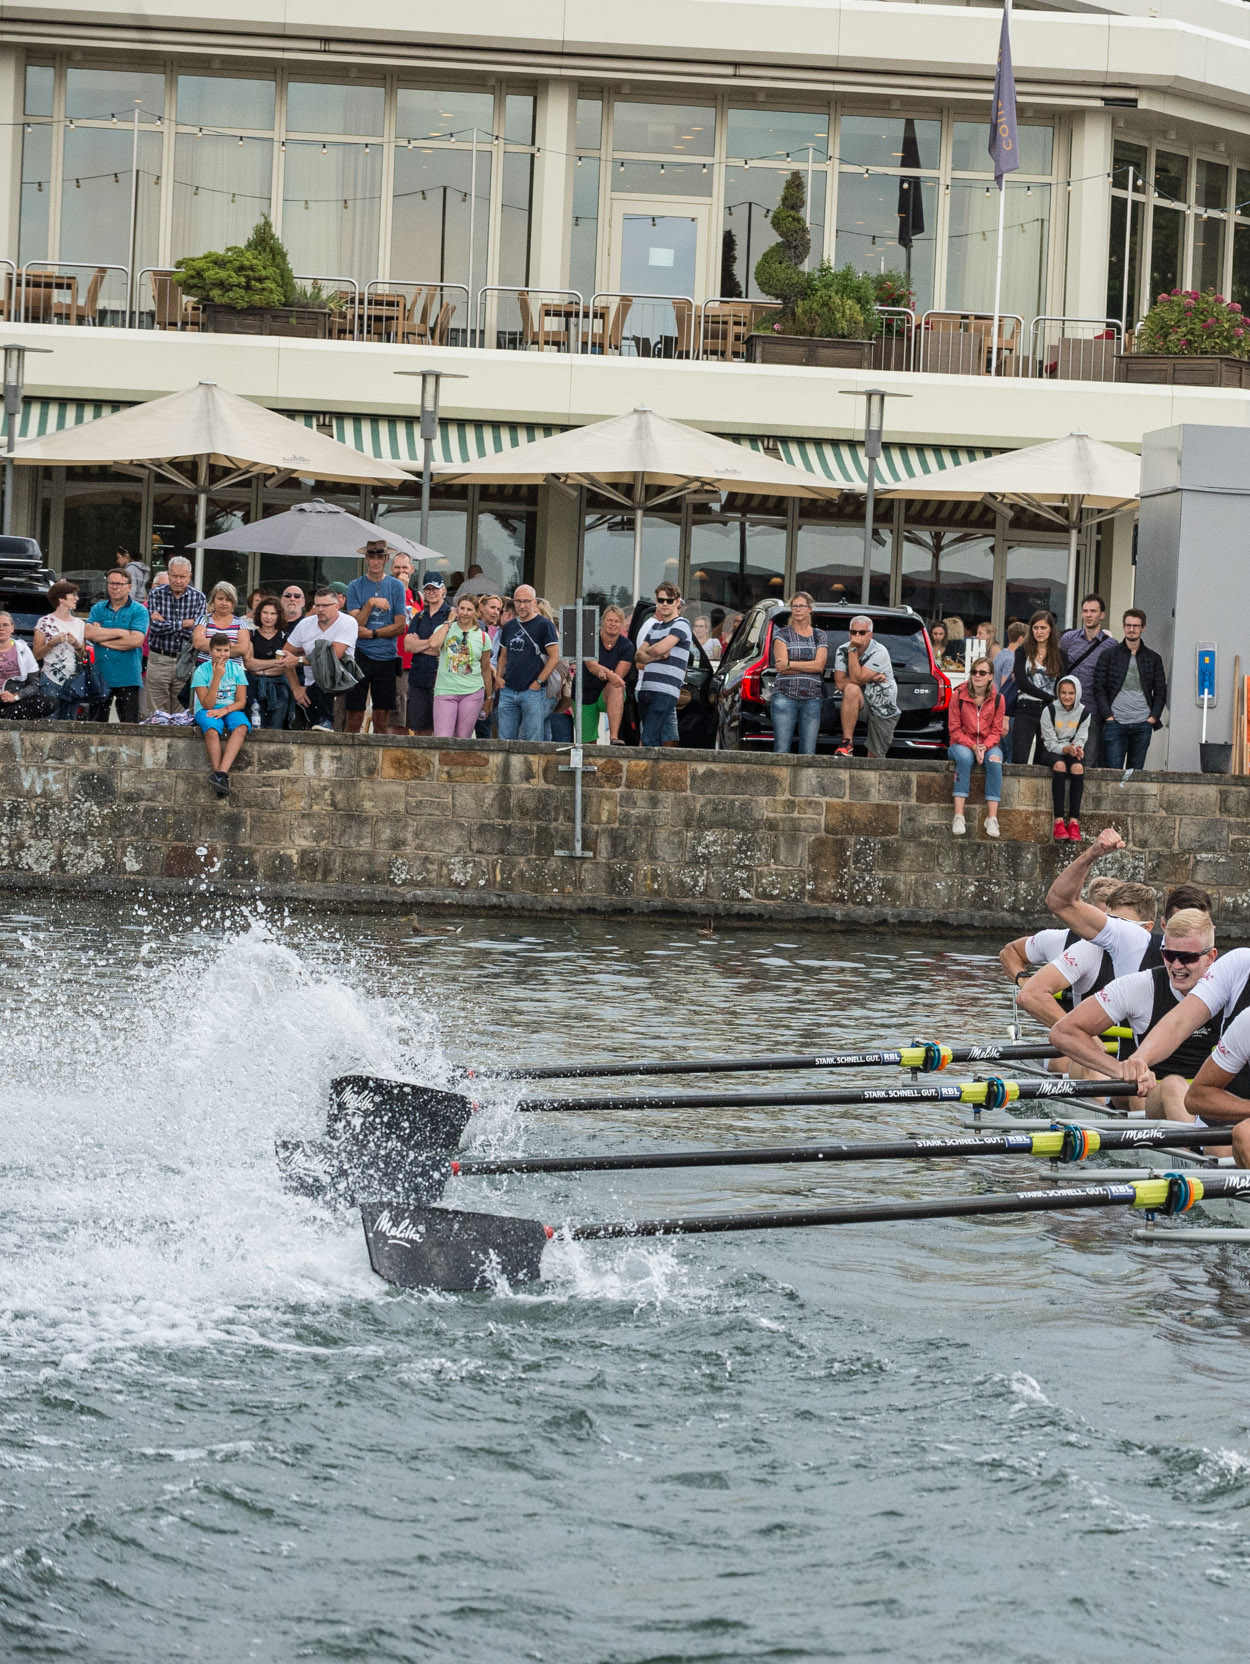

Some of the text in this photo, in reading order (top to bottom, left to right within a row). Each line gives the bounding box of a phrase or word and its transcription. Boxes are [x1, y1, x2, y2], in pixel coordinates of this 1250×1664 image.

[815, 1057, 836, 1065] STARK.
[837, 1055, 865, 1064] SCHNELL.
[866, 1054, 880, 1062] GUT.
[884, 1053, 900, 1061] RBL
[864, 1089, 888, 1098] STARK.
[888, 1088, 921, 1098] SCHNELL.
[921, 1088, 938, 1097] GUT.
[941, 1086, 960, 1095] RBL
[916, 1139, 945, 1147] STARK.
[945, 1137, 983, 1146] SCHNELL.
[983, 1136, 1004, 1145] GUT.
[1017, 1190, 1046, 1199] STARK.
[1047, 1187, 1086, 1197] SCHNELL.
[1086, 1186, 1106, 1196] GUT.
[373, 1209, 424, 1243] Melitta
